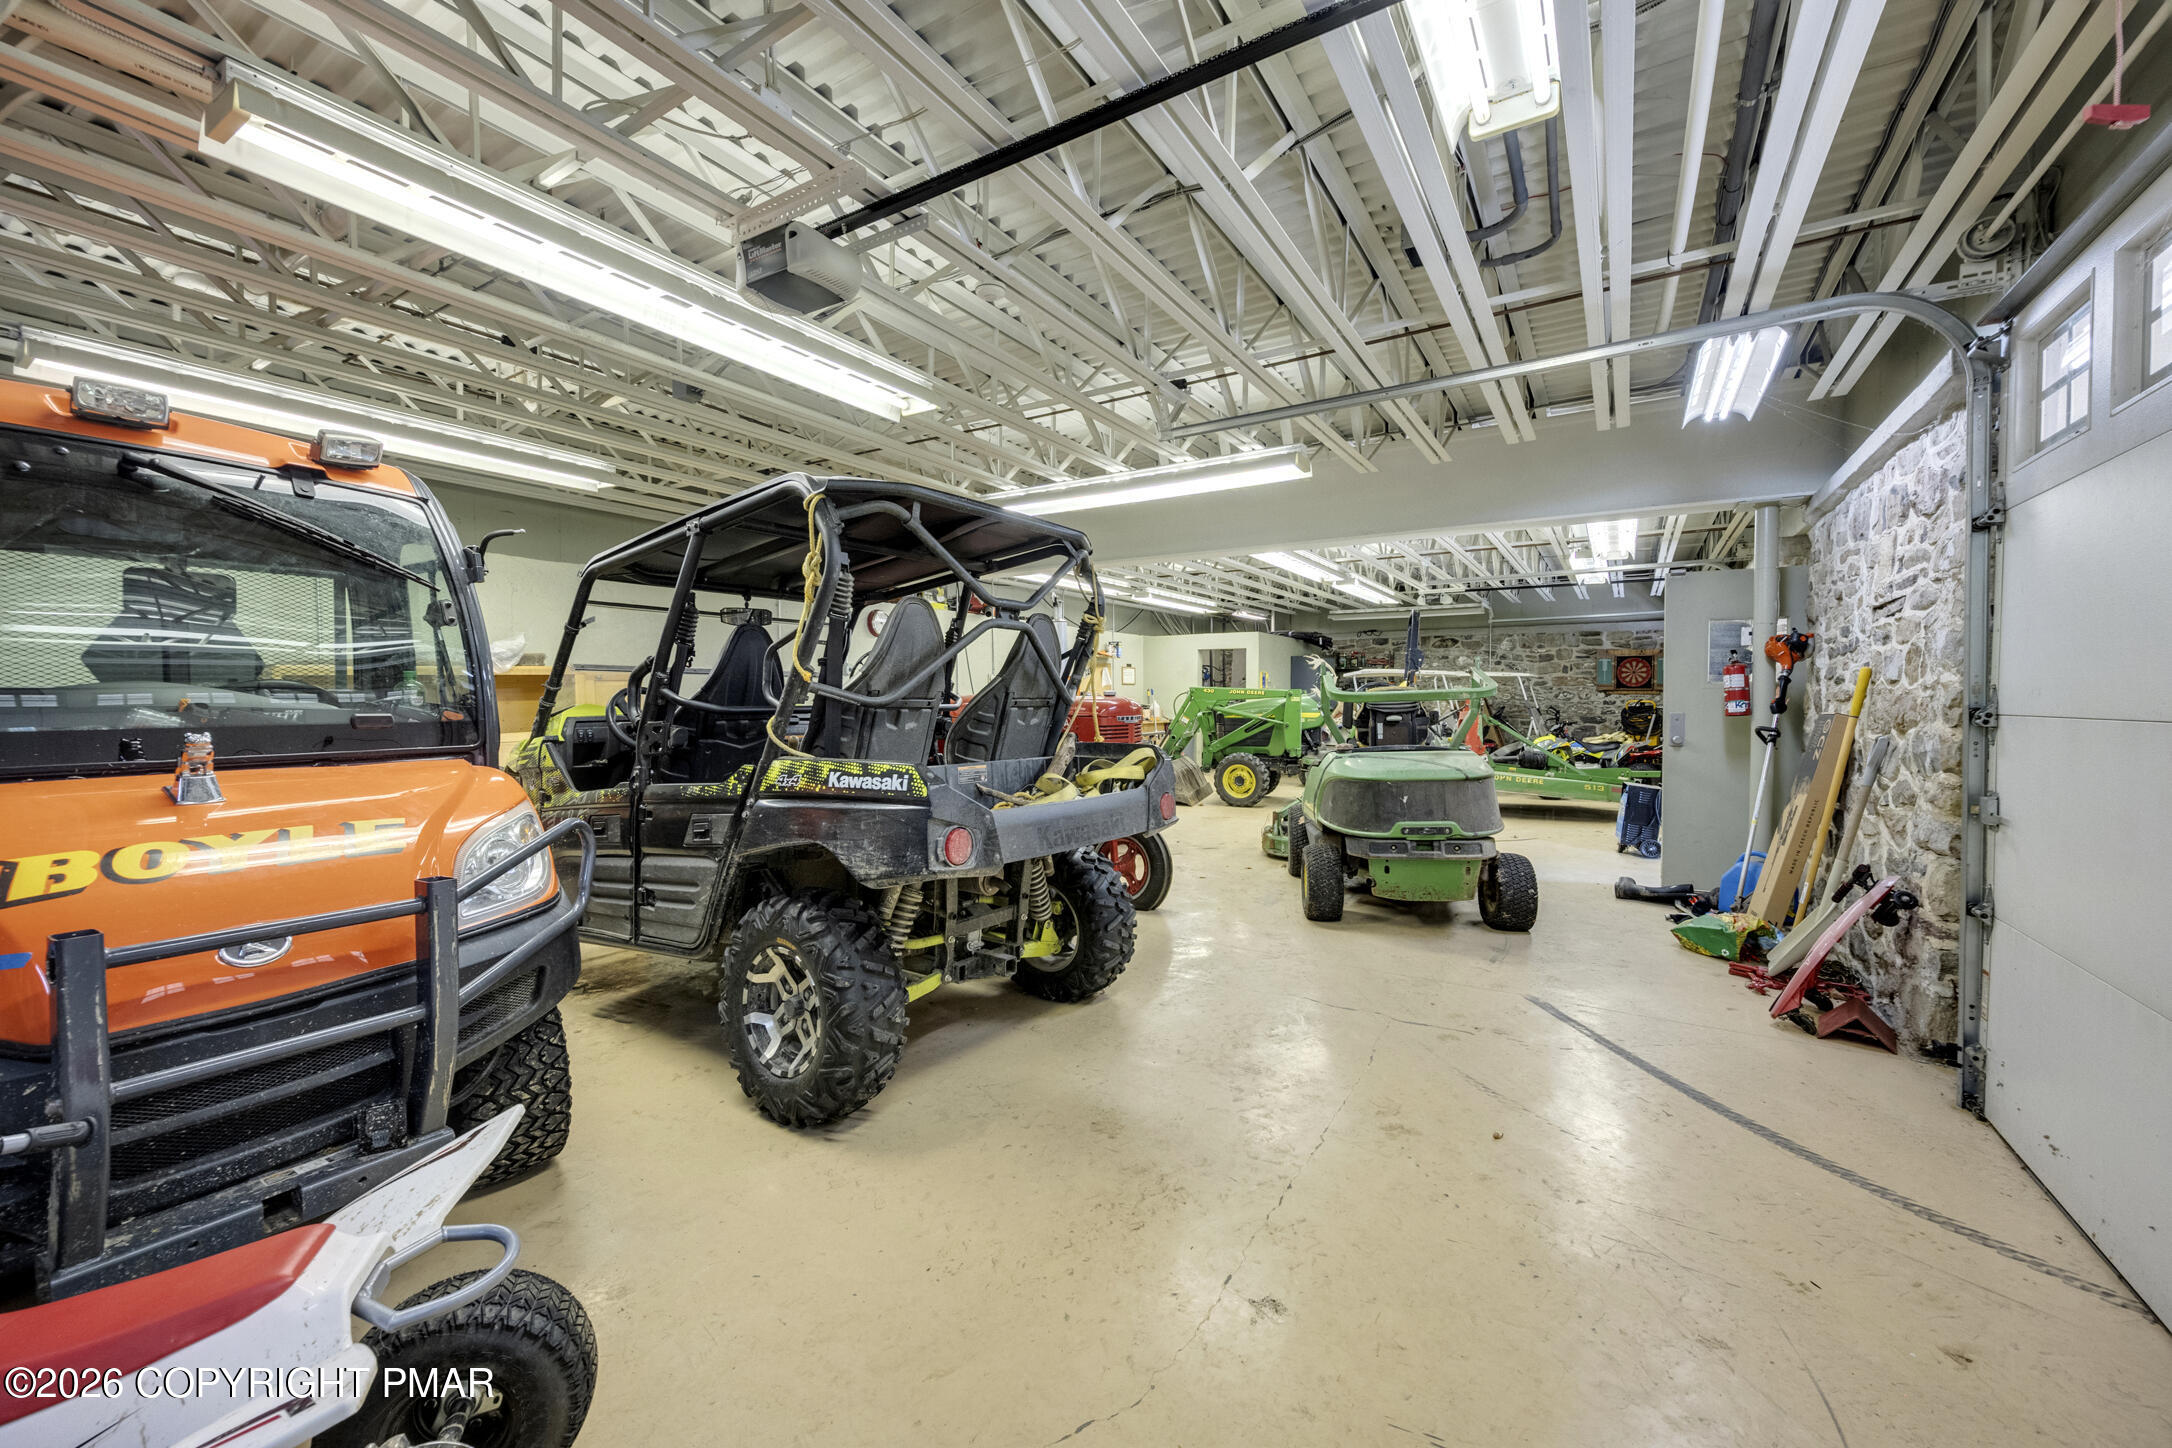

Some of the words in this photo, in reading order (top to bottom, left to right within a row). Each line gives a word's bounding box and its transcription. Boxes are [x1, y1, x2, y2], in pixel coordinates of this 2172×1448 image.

[828, 771, 909, 792] Kawasaki
[1515, 776, 1545, 785] DEERE
[1583, 783, 1605, 792] 513
[2, 817, 406, 904] BOYLE
